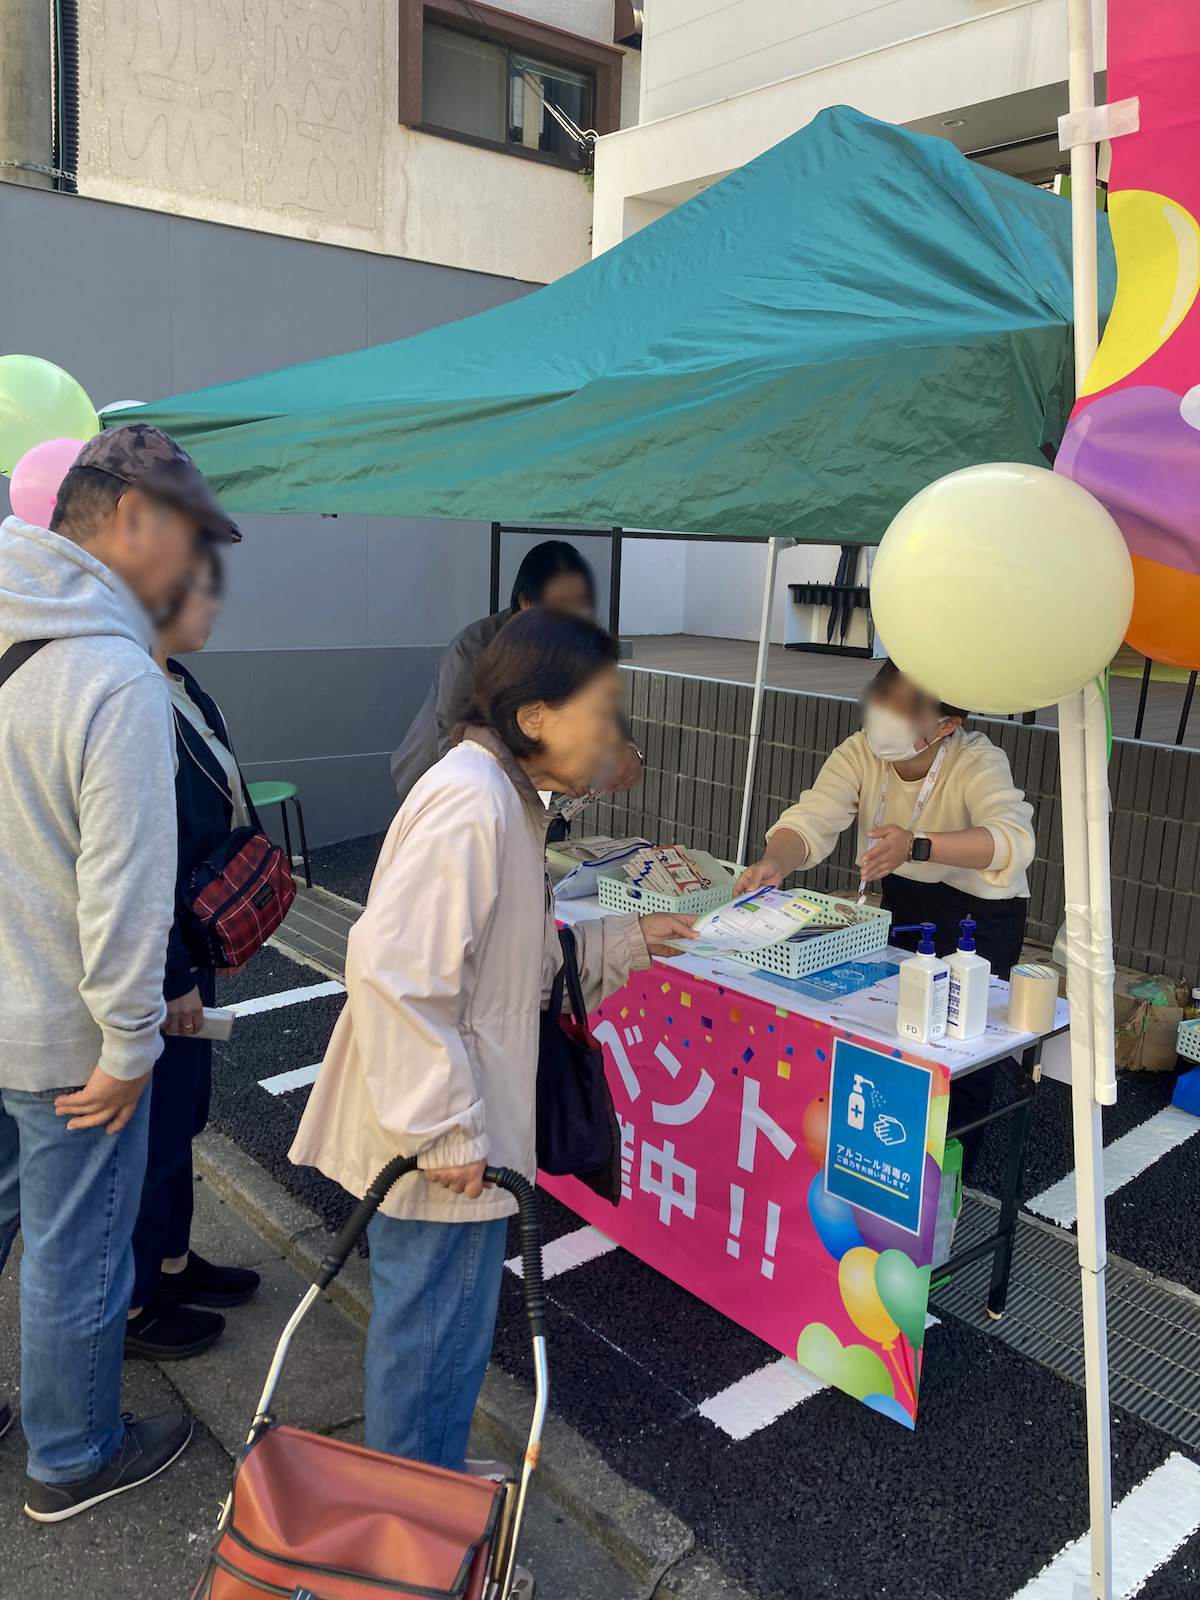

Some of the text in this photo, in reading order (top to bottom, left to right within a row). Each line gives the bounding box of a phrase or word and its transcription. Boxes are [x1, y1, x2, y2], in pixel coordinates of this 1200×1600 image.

[906, 1024, 918, 1034] FD
[932, 1025, 941, 1035] FD
[836, 1143, 911, 1183] アルコール消毒の
[836, 1154, 909, 1192] ご協力をお願い致します。
